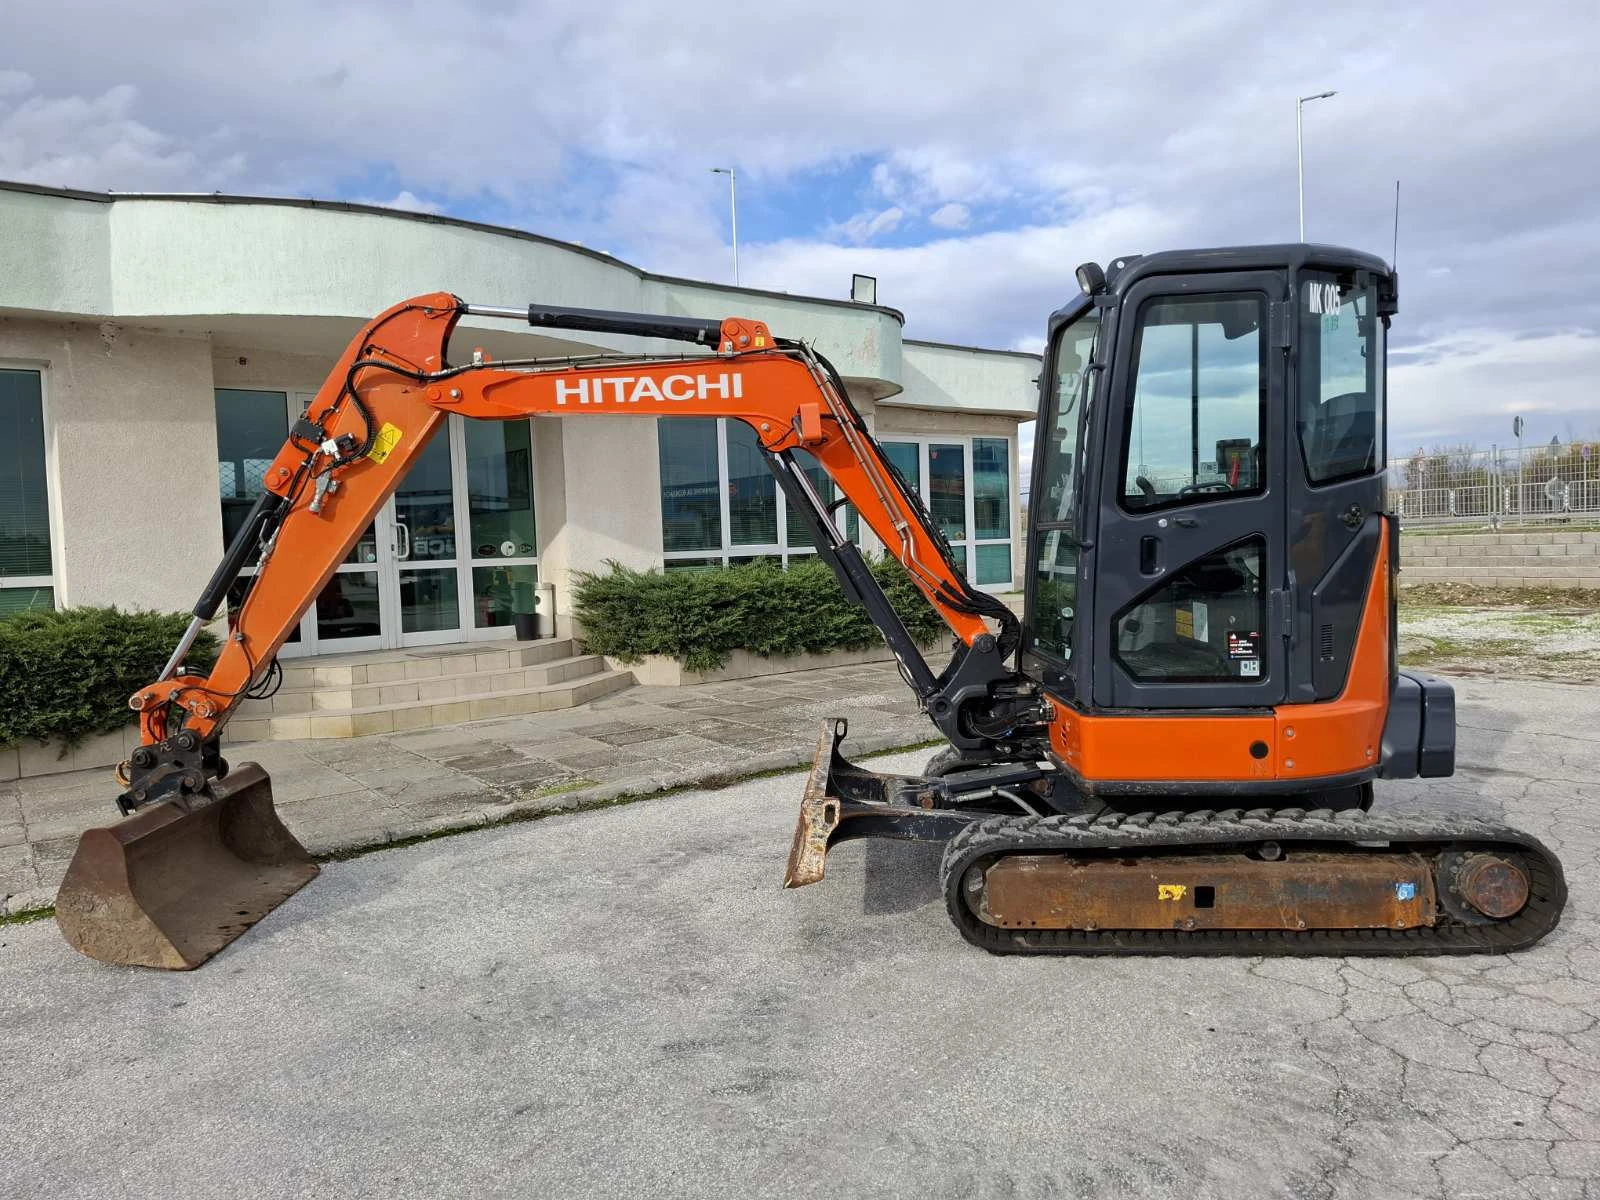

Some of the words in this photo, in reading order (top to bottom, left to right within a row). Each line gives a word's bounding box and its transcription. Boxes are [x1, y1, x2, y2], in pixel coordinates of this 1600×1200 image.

[1309, 282, 1322, 314] MK
[1324, 284, 1341, 315] 005
[555, 373, 744, 405] HITACHI
